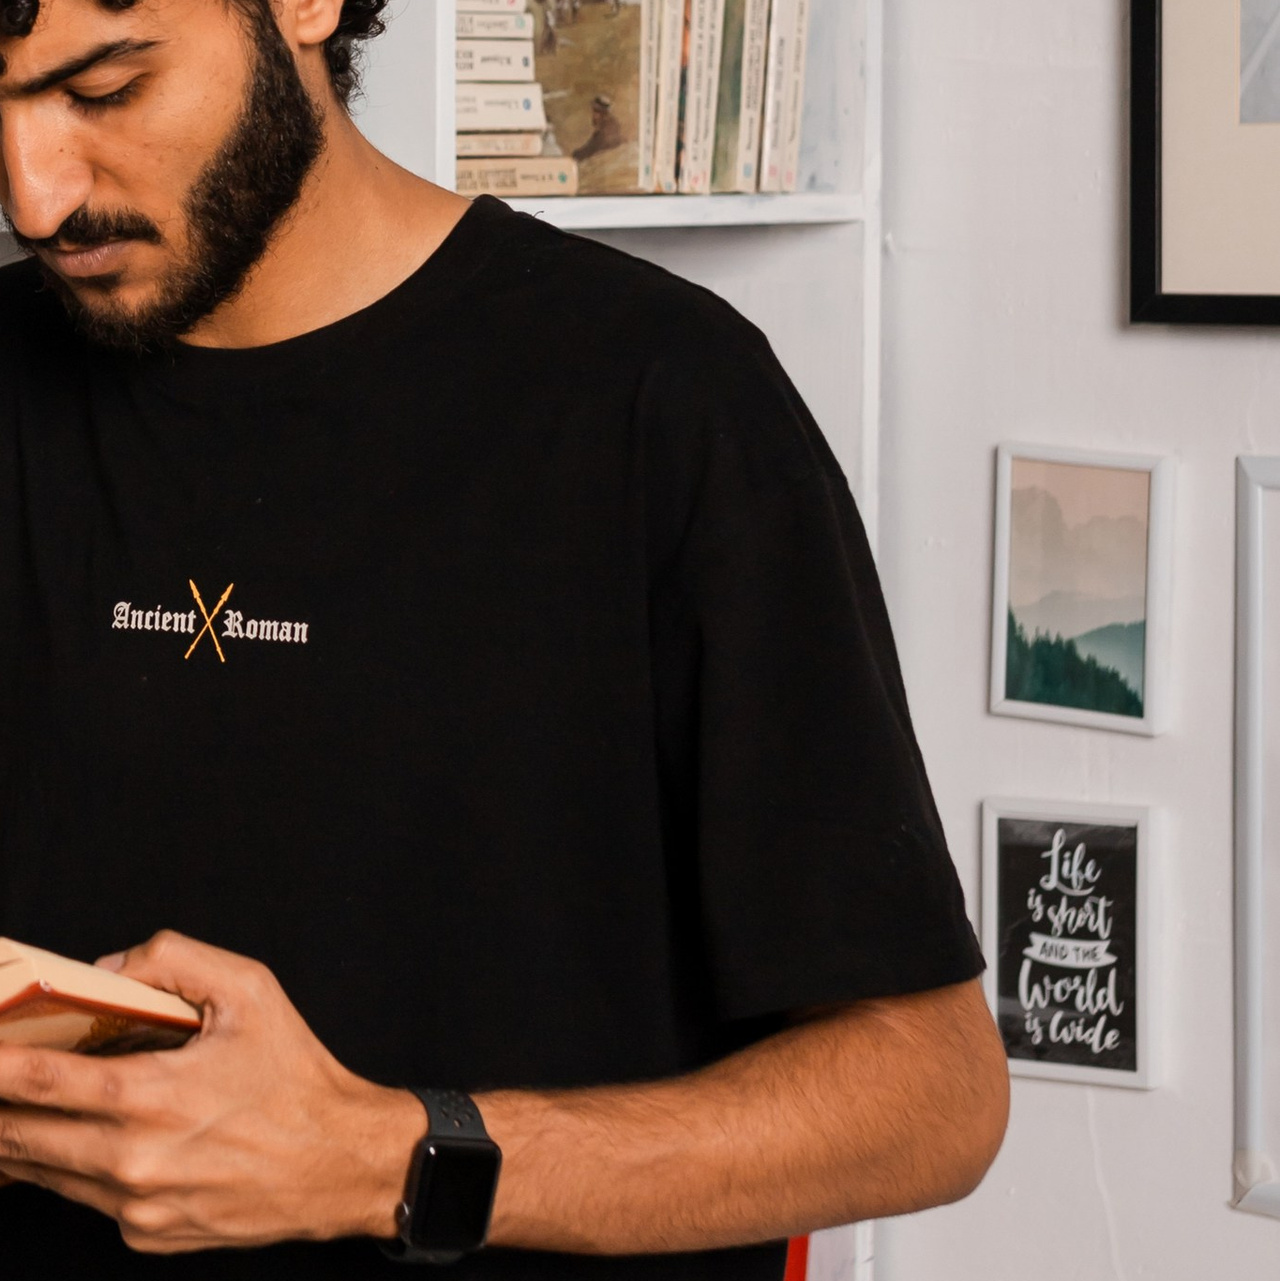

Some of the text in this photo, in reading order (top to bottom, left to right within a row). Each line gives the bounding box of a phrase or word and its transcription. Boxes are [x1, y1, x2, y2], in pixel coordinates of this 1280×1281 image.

[111, 601, 309, 644] Ancient Roman
[1038, 828, 1103, 897] Life
[1026, 887, 1114, 940] is short
[1038, 941, 1102, 962] AND THE
[1024, 1010, 1045, 1046] is
